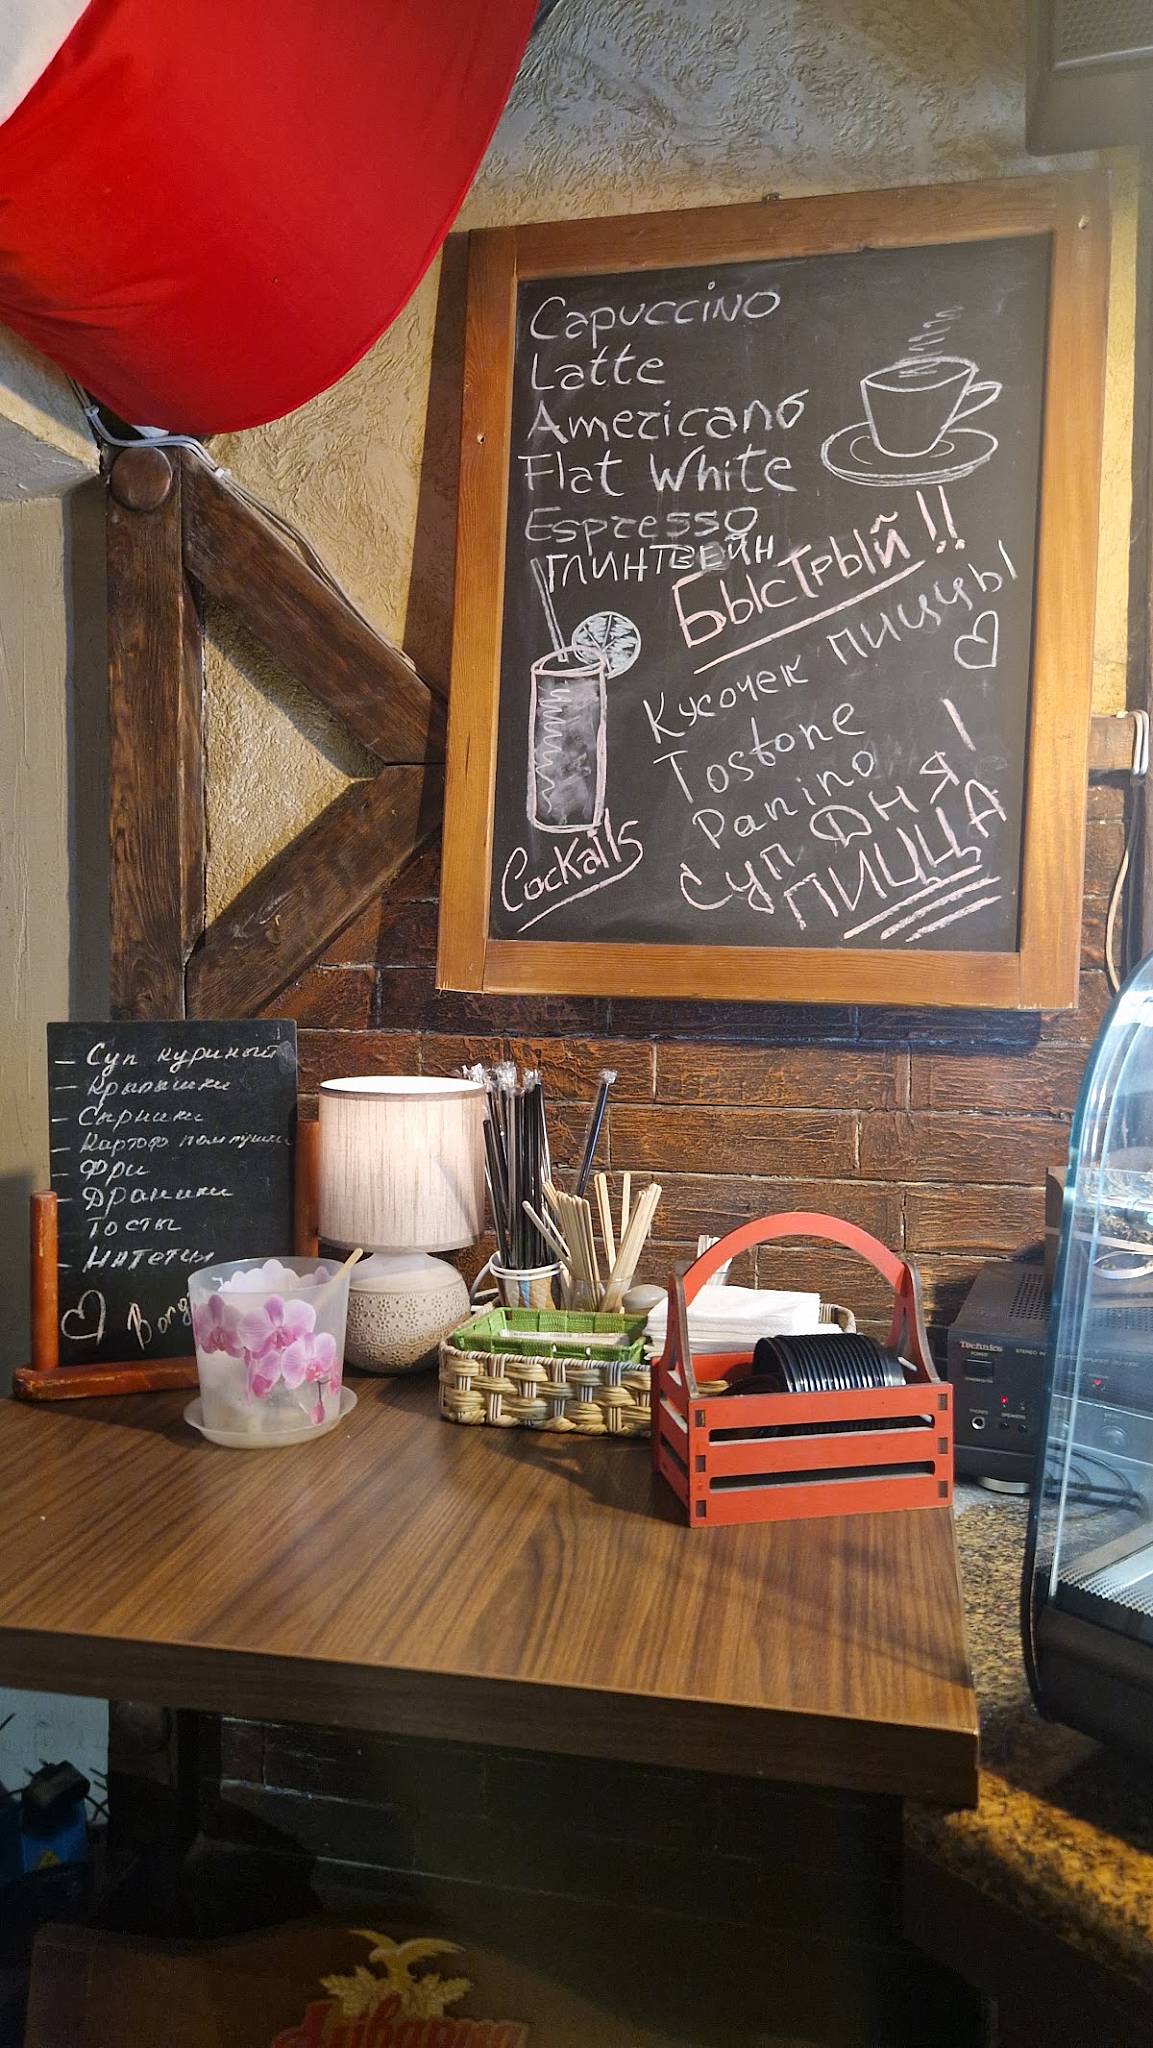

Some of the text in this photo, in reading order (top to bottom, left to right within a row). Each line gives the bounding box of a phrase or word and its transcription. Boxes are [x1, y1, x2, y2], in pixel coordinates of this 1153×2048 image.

[531, 344, 666, 391] Latte
[527, 389, 810, 445] Americano
[518, 444, 798, 497] Flat White
[525, 506, 758, 556] Espresso
[654, 703, 866, 804] Tostone
[86, 1042, 139, 1077] Суп
[79, 1159, 151, 1187] Фри
[127, 1291, 192, 1350] Borg
[959, 1340, 1003, 1352] Technics
